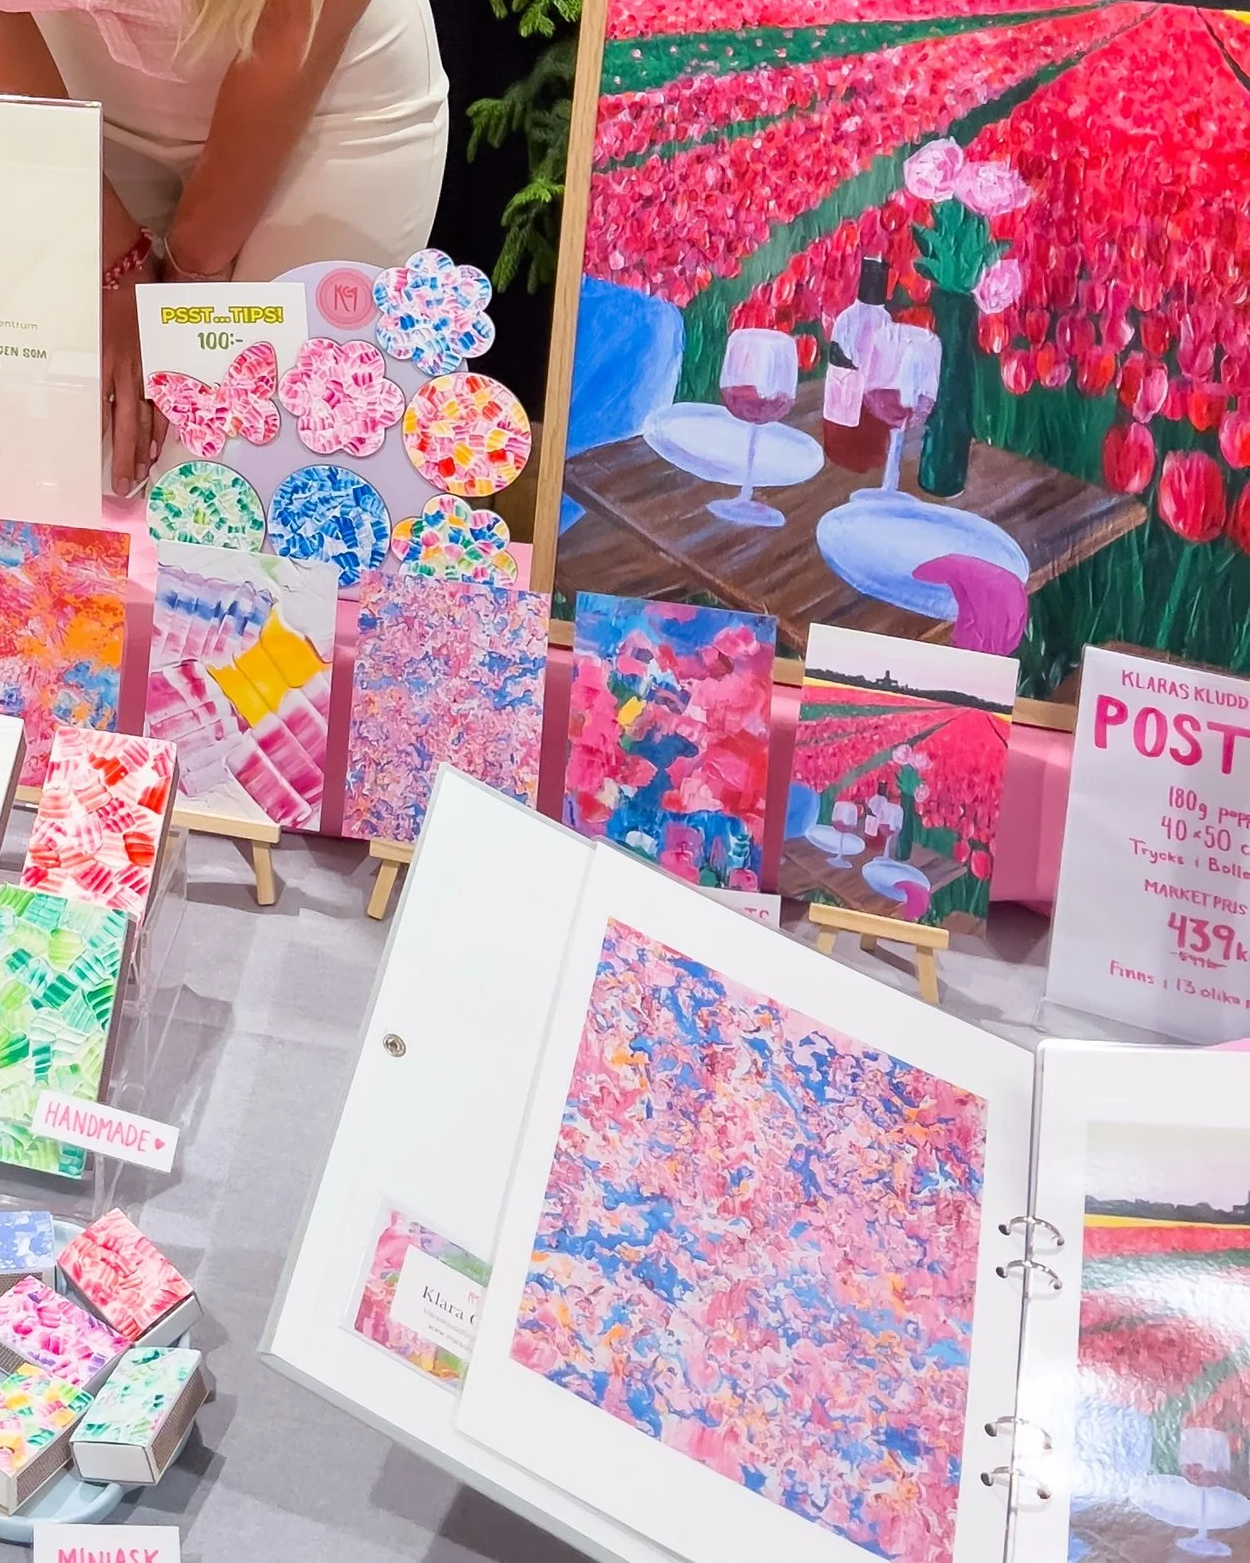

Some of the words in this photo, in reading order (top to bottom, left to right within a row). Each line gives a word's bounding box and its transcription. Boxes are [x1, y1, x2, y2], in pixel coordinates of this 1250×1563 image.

[22, 347, 47, 360] SOM
[1121, 669, 1190, 700] KLARAS
[1194, 686, 1249, 710] KLUDD
[1094, 694, 1250, 775] POST
[1169, 786, 1208, 821] 180g
[1129, 838, 1184, 864] Trycks
[1110, 959, 1155, 984] Finns
[1176, 977, 1196, 994] 13
[1200, 987, 1240, 1004] olika
[45, 1101, 151, 1152] HANDMADE
[423, 1285, 464, 1320] Klara
